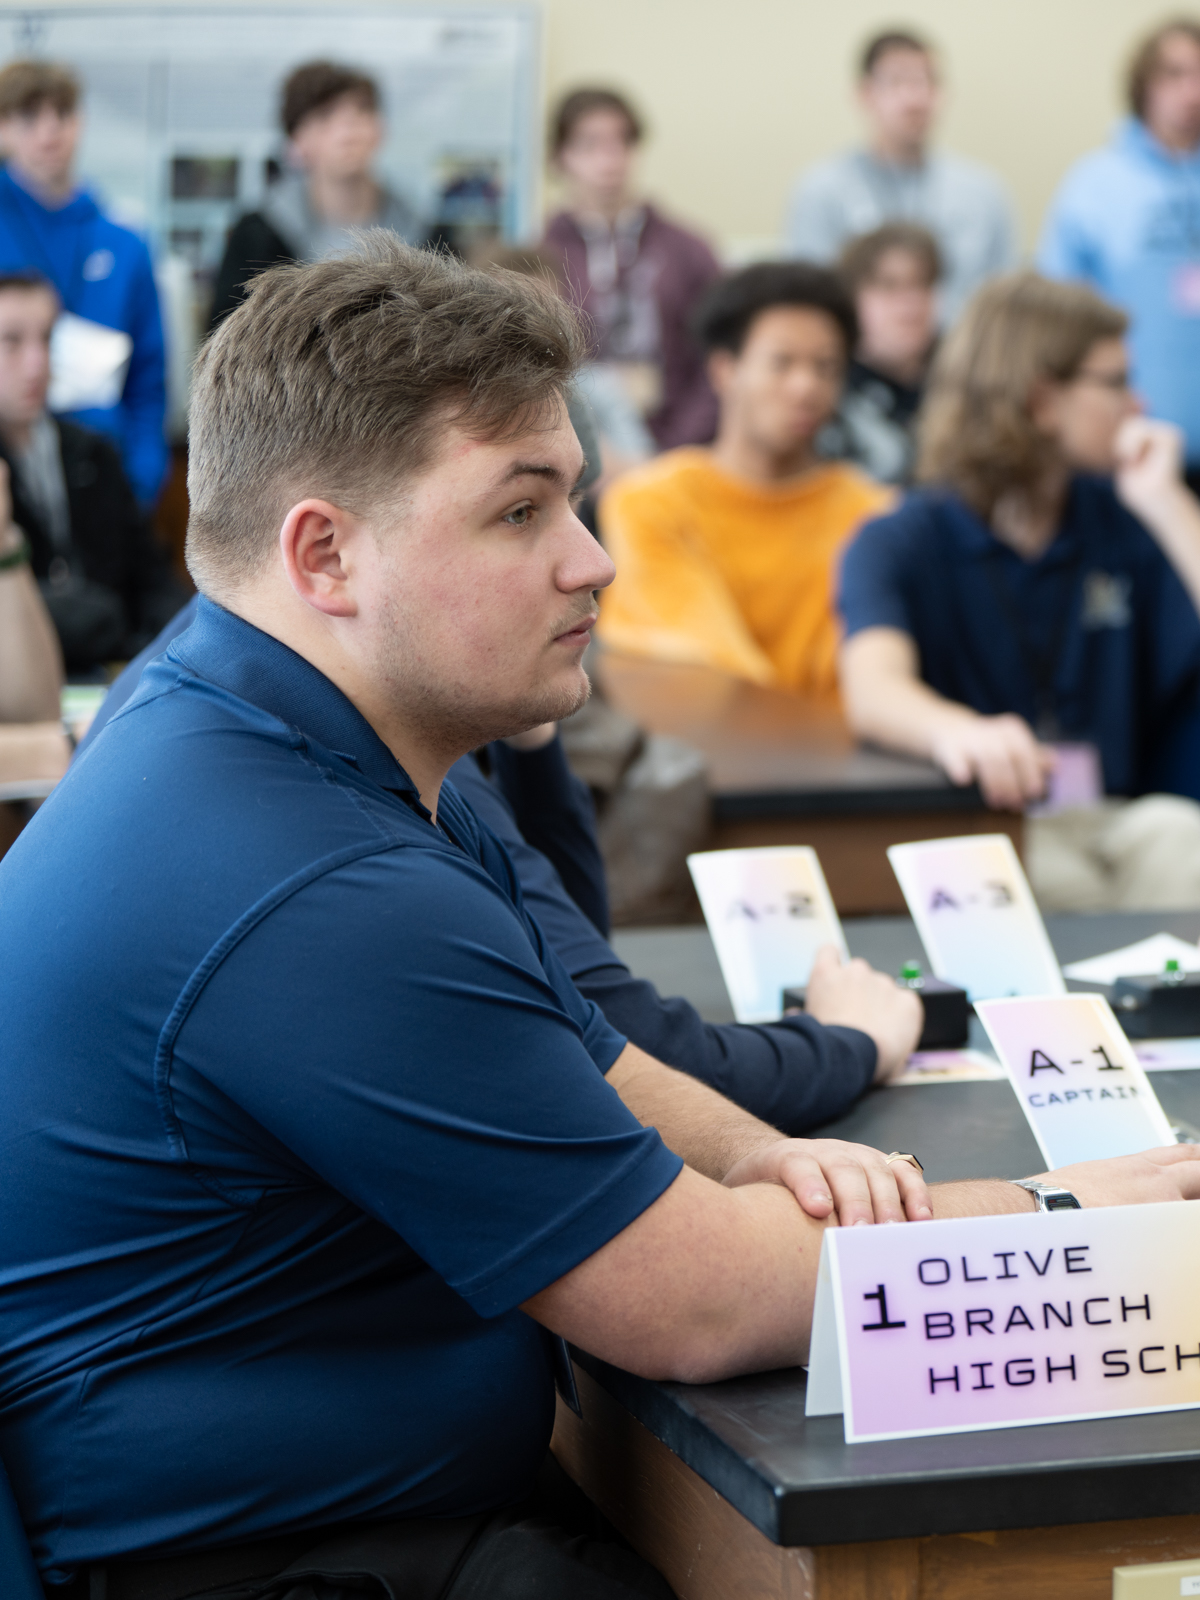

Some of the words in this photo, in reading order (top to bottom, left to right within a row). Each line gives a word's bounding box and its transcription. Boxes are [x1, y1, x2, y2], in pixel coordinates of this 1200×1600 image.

[1029, 1045, 1125, 1078] A-1
[917, 1245, 1093, 1286] OLIVE
[861, 1284, 907, 1332] 1
[923, 1293, 1152, 1340] BRANCH
[928, 1353, 1078, 1395] HIGH
